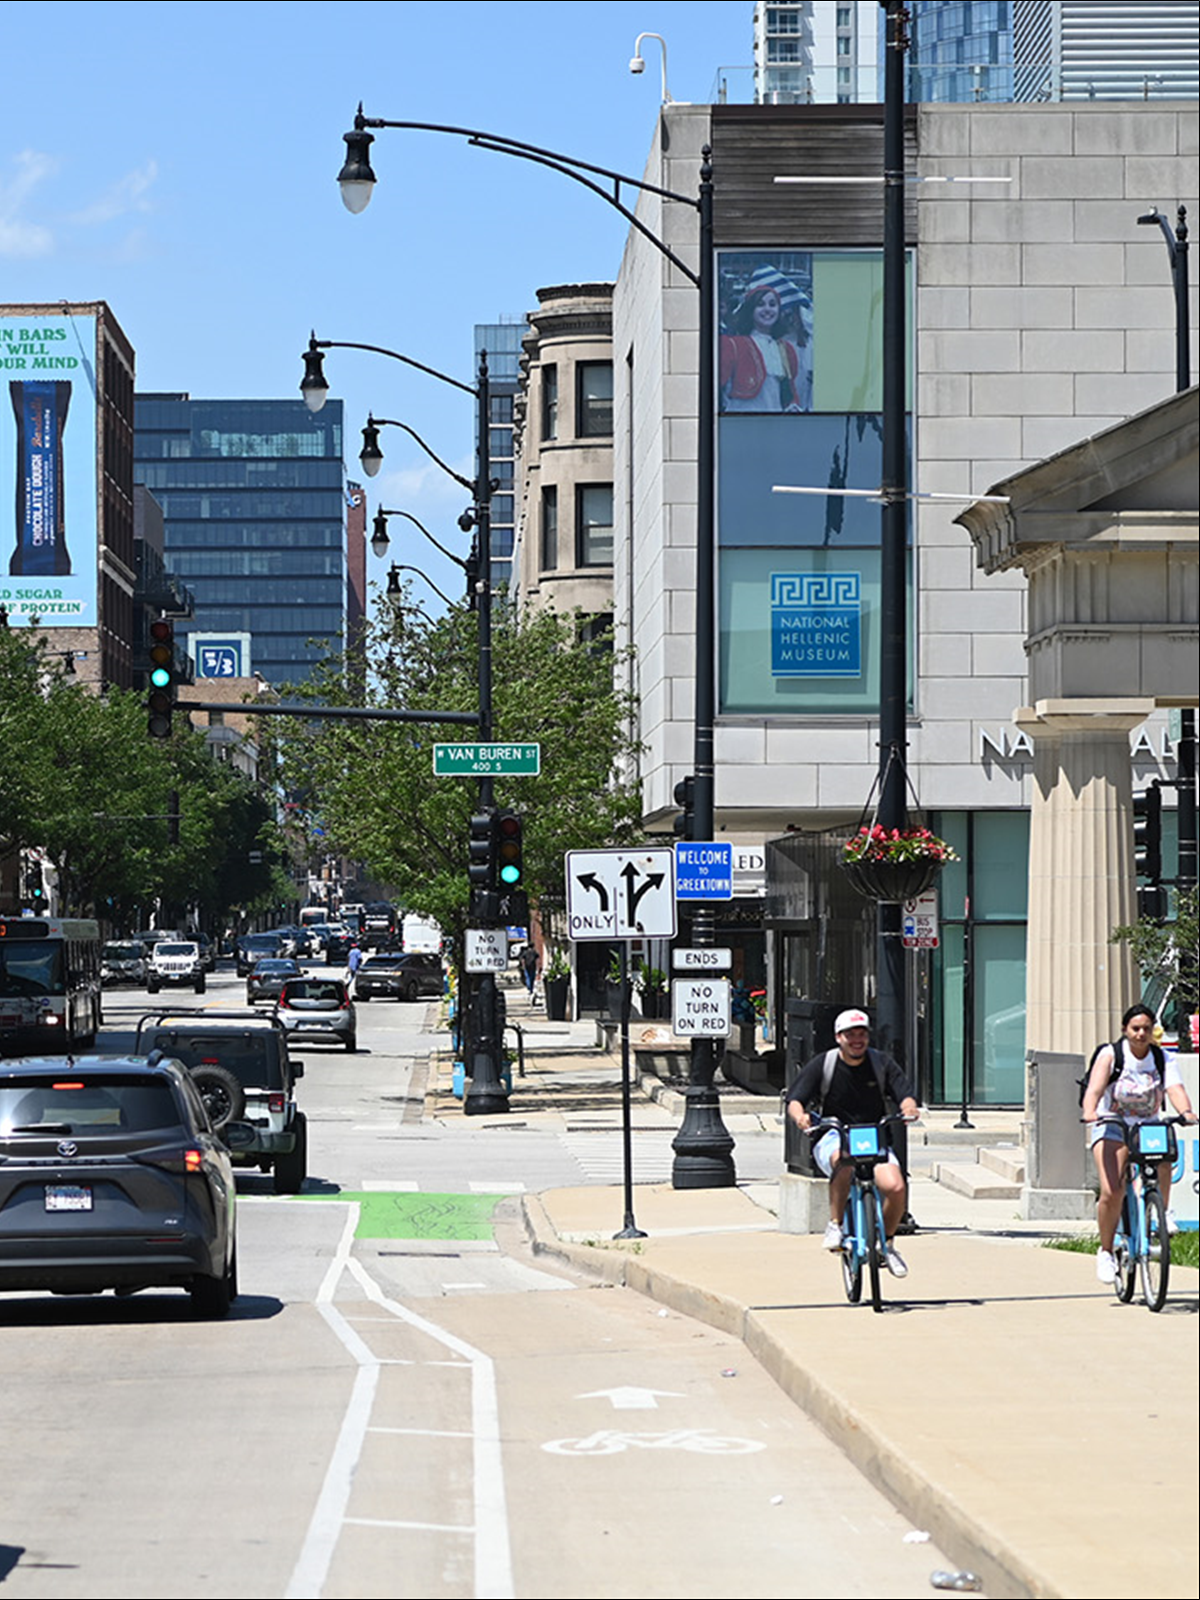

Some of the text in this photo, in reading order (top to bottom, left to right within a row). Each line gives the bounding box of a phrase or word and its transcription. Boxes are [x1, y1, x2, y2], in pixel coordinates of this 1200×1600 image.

[20, 328, 66, 341] BARS
[7, 343, 50, 355] WILL
[31, 356, 78, 369] MIND
[31, 454, 43, 546] CHOCOLATE DOUGH
[15, 589, 62, 599] SUGAR
[20, 602, 81, 613] PROTEIN
[780, 616, 850, 629] NATIONAL
[780, 632, 850, 645] HELLENIC
[780, 648, 850, 661] MUSEUM
[979, 726, 1174, 758] NAAL
[437, 748, 536, 760] W VAN BUREN ST
[472, 762, 502, 771] 400 S
[678, 850, 729, 865] WELCOME
[733, 855, 764, 870] ED
[698, 866, 709, 875] TO
[677, 878, 731, 891] GREEKTOWN
[572, 915, 614, 929] ONLY
[478, 935, 495, 943] NO
[475, 947, 499, 955] TURN
[487, 958, 504, 967] RED
[685, 953, 718, 965] ENDS
[691, 986, 712, 998] NO
[686, 1002, 719, 1014] TURN
[678, 1018, 726, 1029] ON RED
